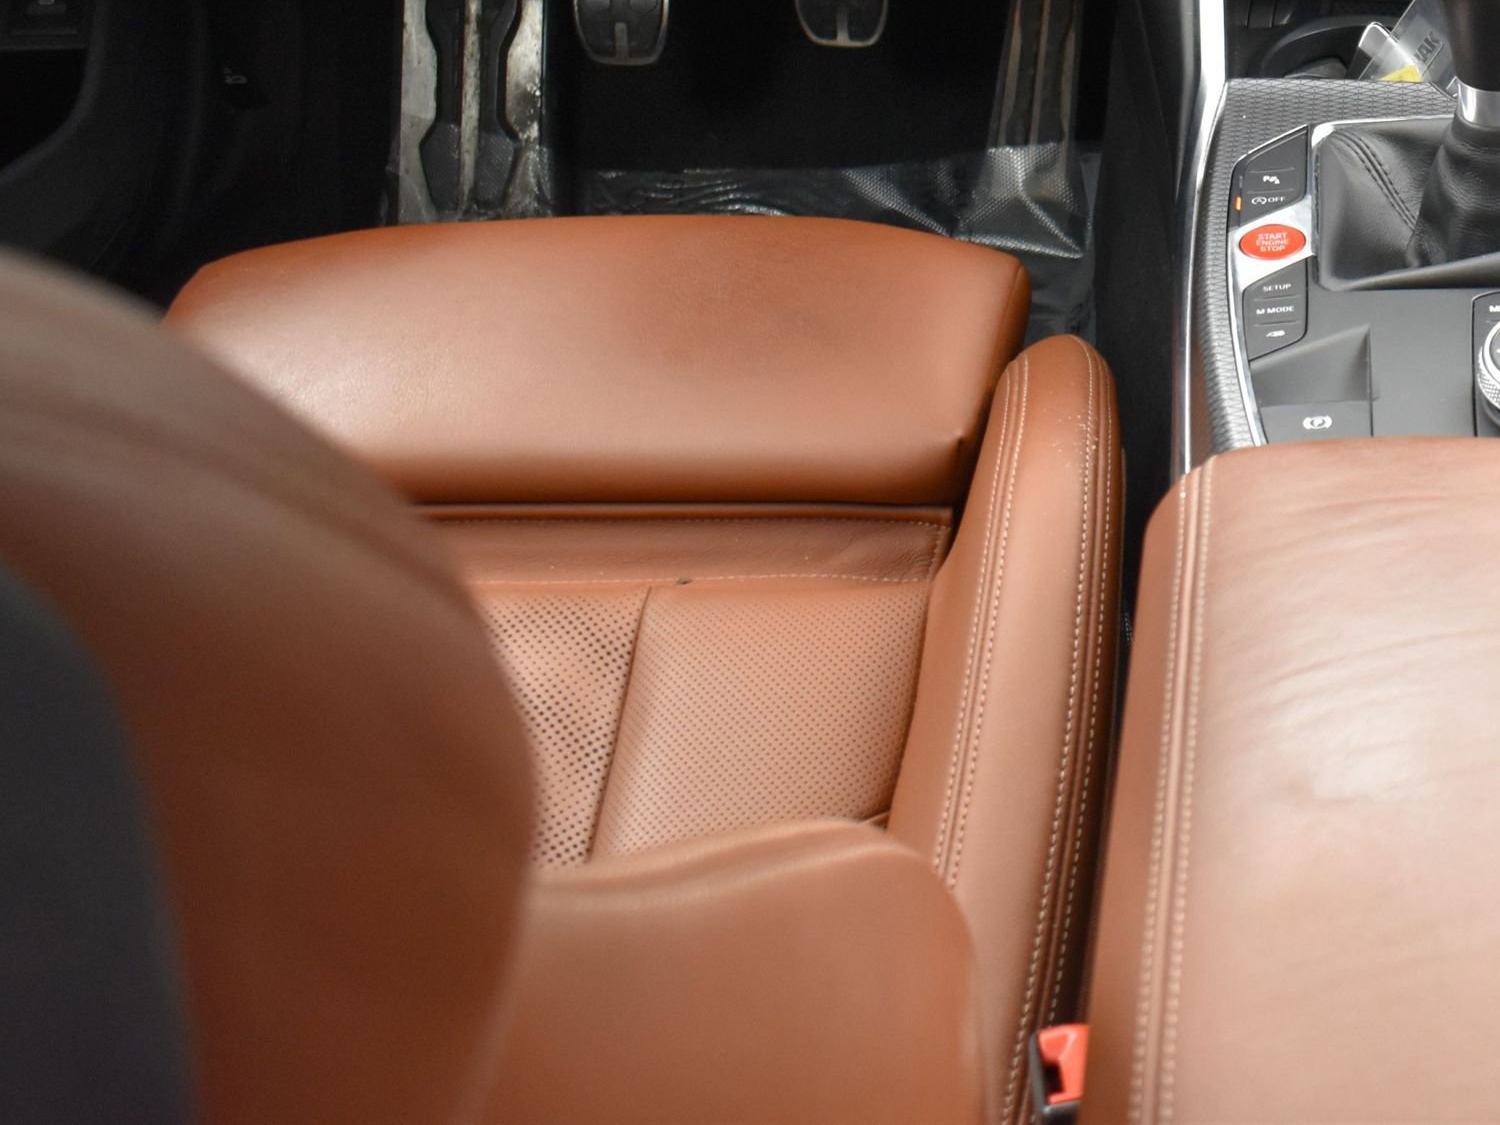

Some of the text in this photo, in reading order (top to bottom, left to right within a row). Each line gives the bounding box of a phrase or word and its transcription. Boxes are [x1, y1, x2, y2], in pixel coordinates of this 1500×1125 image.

[1268, 196, 1286, 204] OFF
[1262, 282, 1292, 292] SETUP
[1266, 305, 1295, 314] MODE
